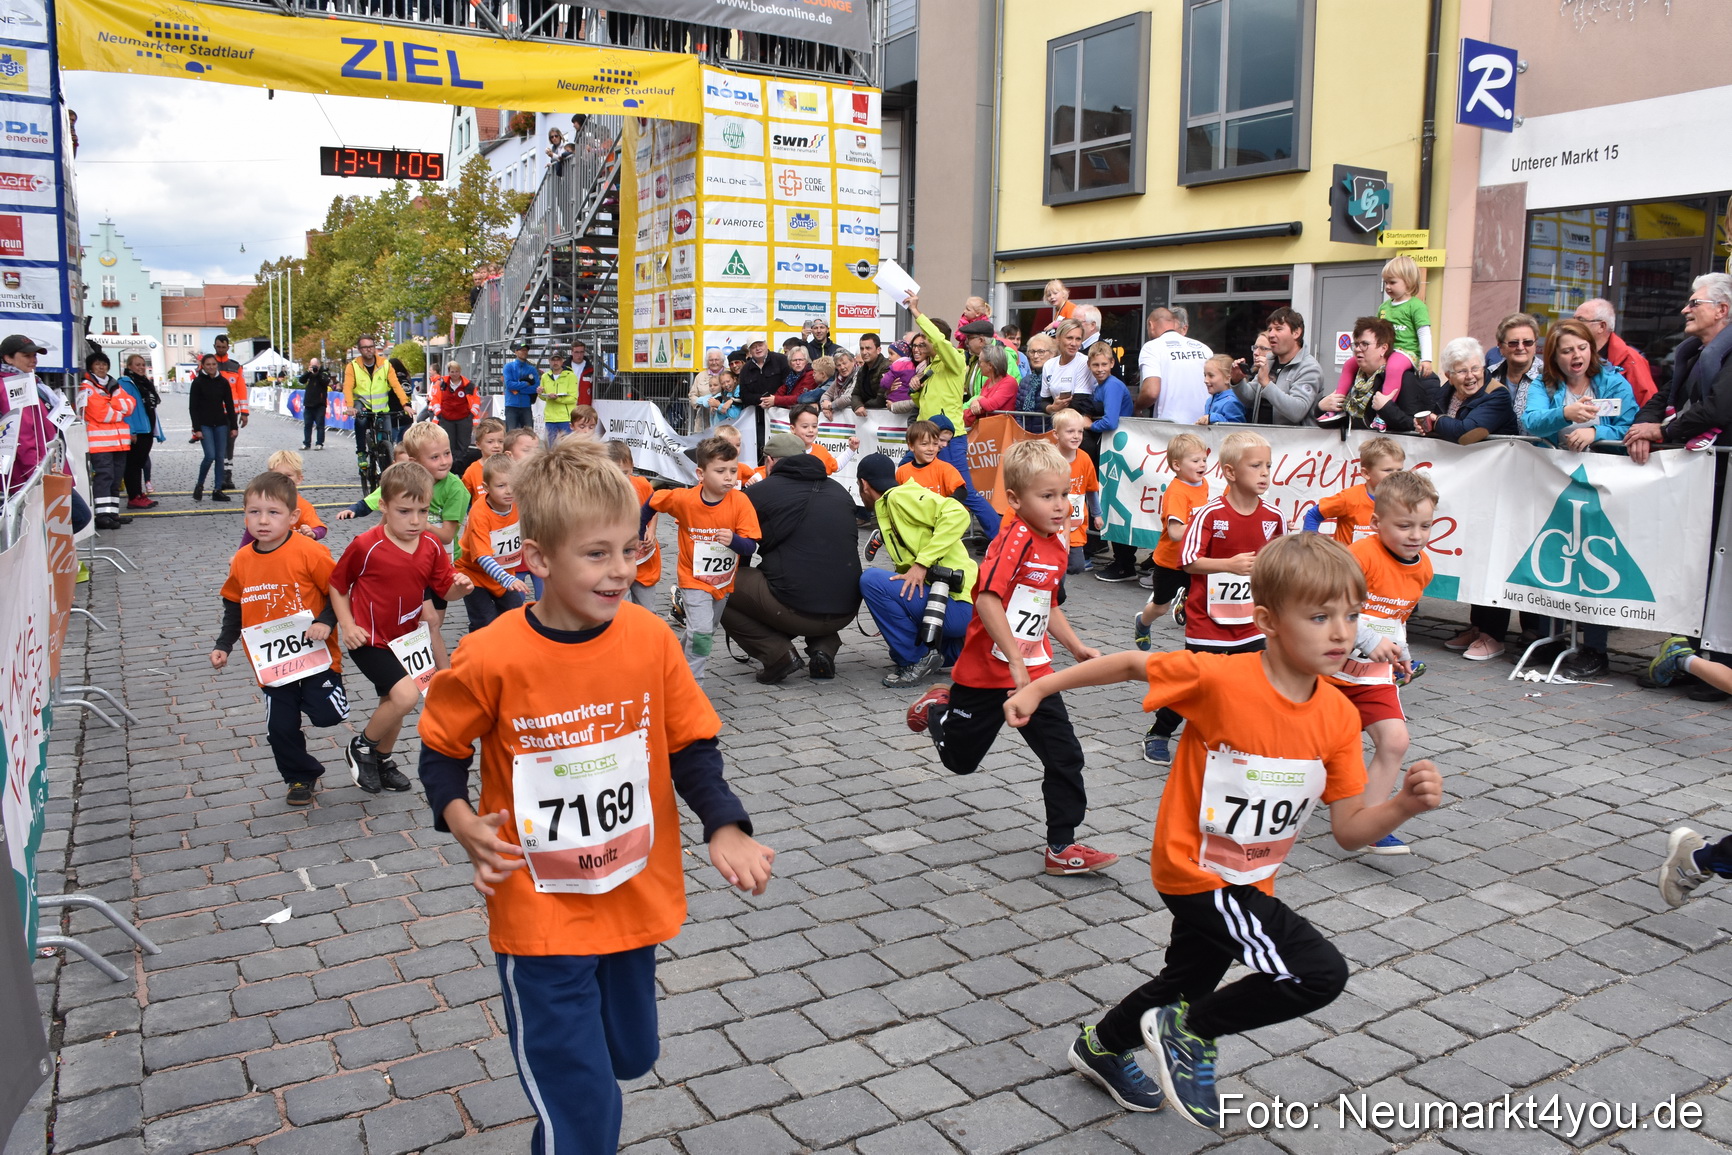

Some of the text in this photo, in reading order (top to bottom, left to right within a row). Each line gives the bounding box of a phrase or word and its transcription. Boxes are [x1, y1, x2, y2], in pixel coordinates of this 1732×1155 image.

[716, 0, 833, 25] www.bockonline.de
[97, 31, 255, 60] Neumarkter Stadtlauf
[341, 37, 484, 90] ZIEL
[556, 79, 675, 97] Neumarkter Stadtlauf
[6, 133, 48, 145] energie
[773, 133, 808, 148] swn
[1511, 144, 1619, 173] Unterer Markt 15
[804, 177, 822, 185] CODE
[804, 184, 826, 193] CLINIC
[722, 218, 764, 229] VARIOTEC
[804, 272, 830, 280] energie
[110, 337, 147, 347] Laufsport
[1170, 351, 1208, 360] STAFFEL
[967, 439, 997, 456] ODE
[967, 453, 1004, 470] LINIC
[240, 592, 271, 604] tadtlauf
[1503, 588, 1656, 621] Jura Gebäude Service GmbH
[260, 630, 314, 663] 7264
[272, 658, 306, 677] FELIX
[512, 702, 615, 733] Neumarkter
[518, 723, 595, 750] Stadtlauf
[568, 753, 618, 775] BOCK
[1260, 770, 1306, 783] BOCK
[538, 781, 634, 842] 7169
[1225, 795, 1310, 837] 7194
[526, 839, 537, 847] B2
[578, 847, 619, 870] Moritz
